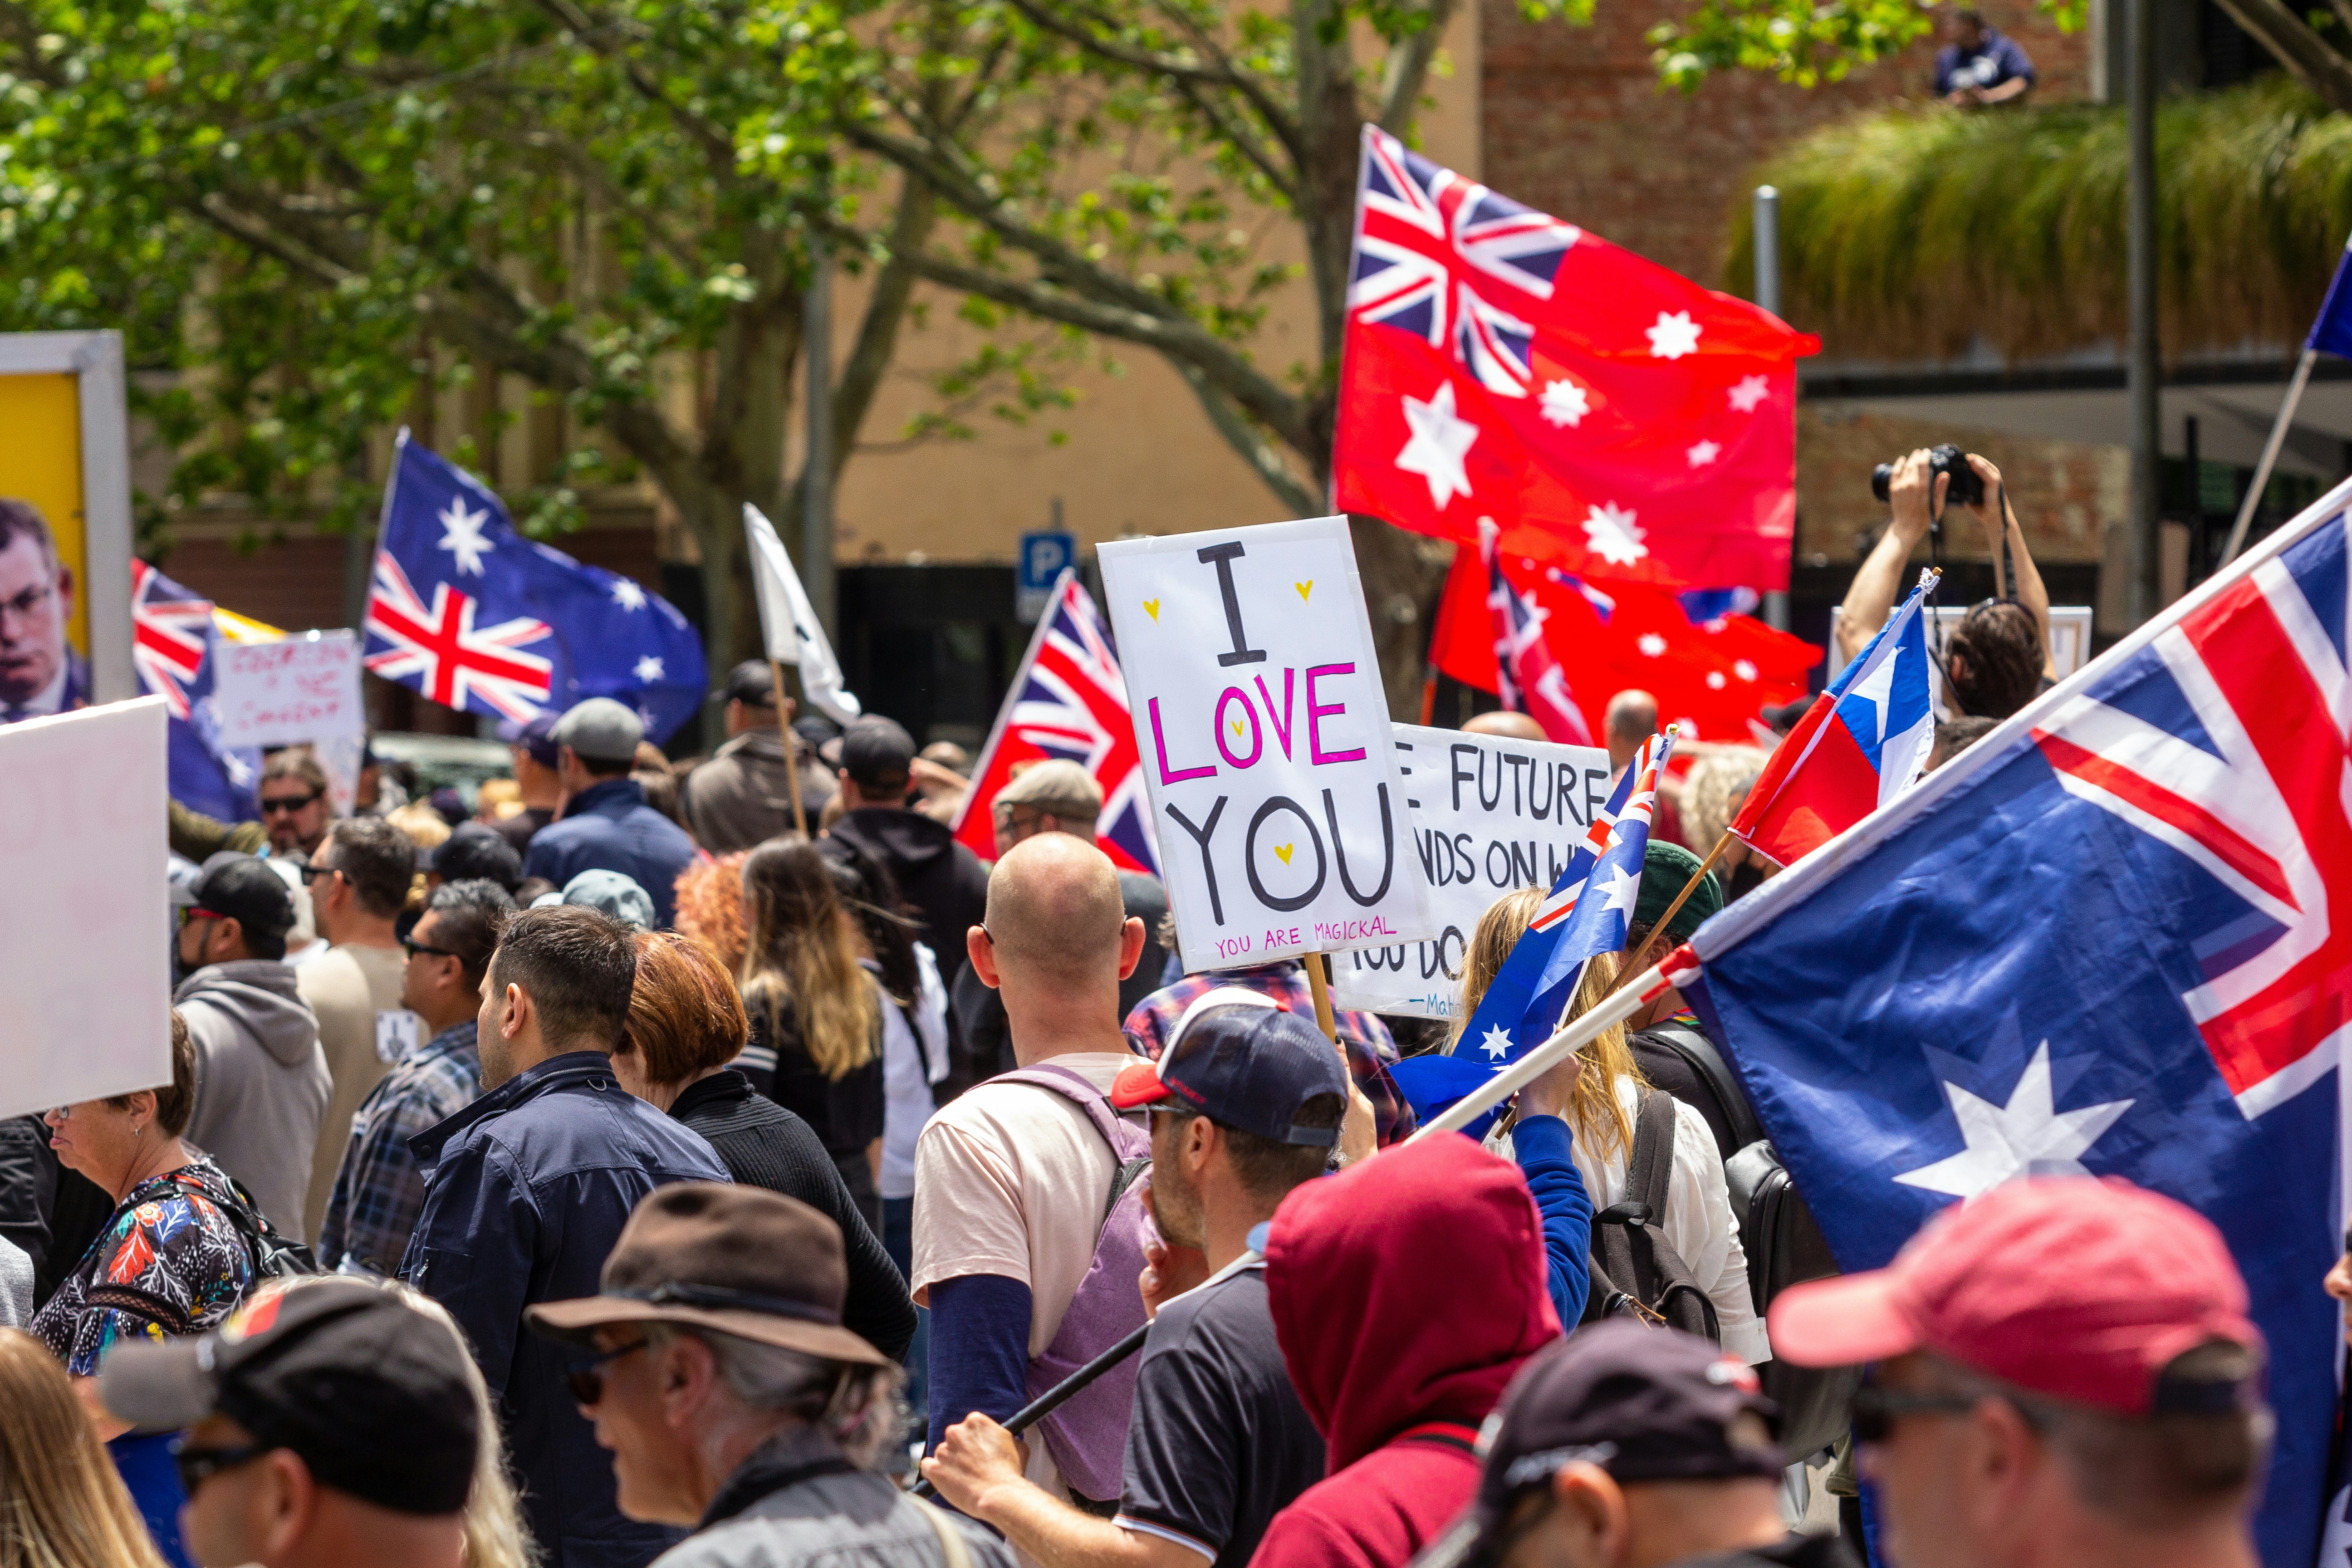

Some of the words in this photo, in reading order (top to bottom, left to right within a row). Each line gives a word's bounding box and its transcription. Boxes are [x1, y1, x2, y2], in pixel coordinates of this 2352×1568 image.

[1031, 540, 1063, 582] P
[1197, 541, 1267, 667] I
[1148, 662, 1367, 786] LOVE
[1450, 744, 1609, 828] FUTURE
[1165, 782, 1394, 926] YOU
[1486, 840, 1537, 888] ON
[1215, 936, 1250, 959] YOU
[1264, 927, 1301, 950] ARE
[1314, 915, 1397, 941] MAGICKAL
